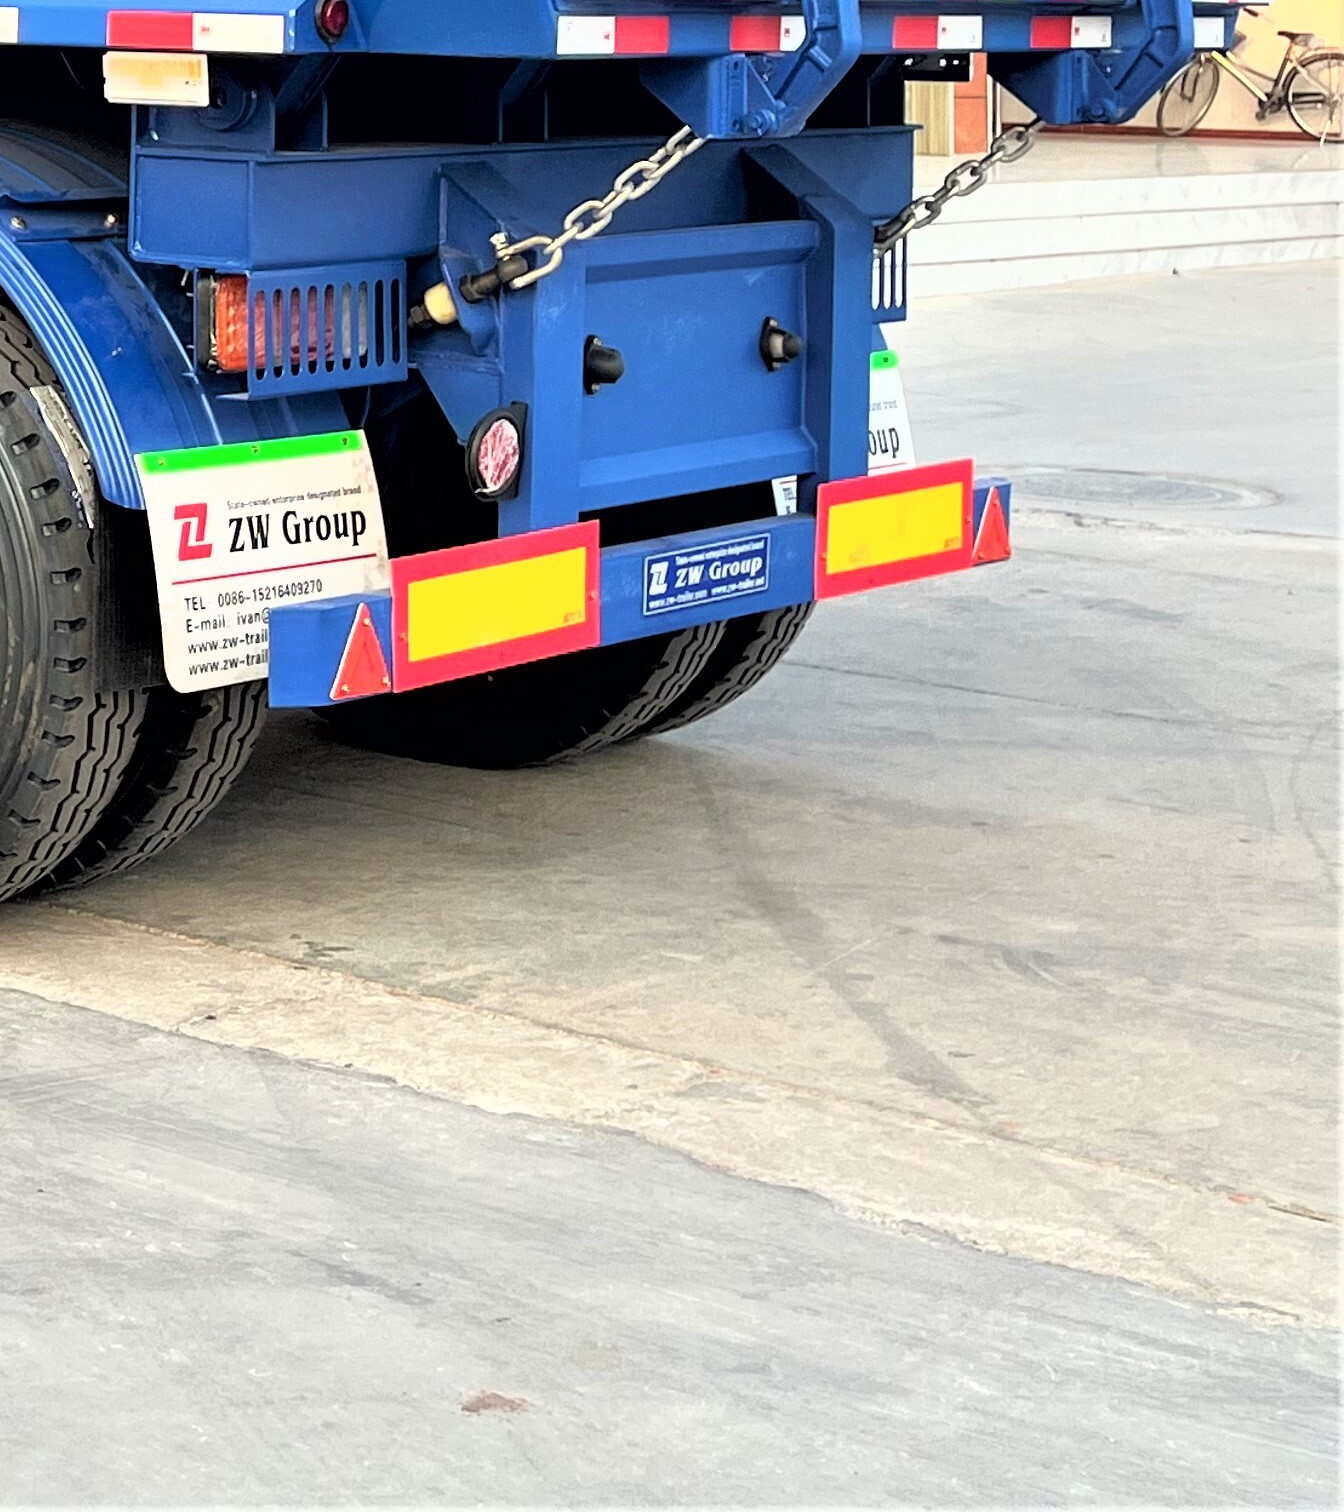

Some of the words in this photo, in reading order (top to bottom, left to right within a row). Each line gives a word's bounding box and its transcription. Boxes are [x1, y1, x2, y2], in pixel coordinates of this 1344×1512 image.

[868, 427, 899, 458] oup
[229, 513, 269, 552] ZW
[282, 510, 366, 546] Group
[675, 565, 704, 588] ZW
[709, 557, 762, 580] Group
[217, 578, 323, 607] 0086-15216409270
[237, 607, 269, 625] ivan@
[188, 629, 268, 654] www.zw-trail
[189, 649, 269, 675] www.zw-trail
